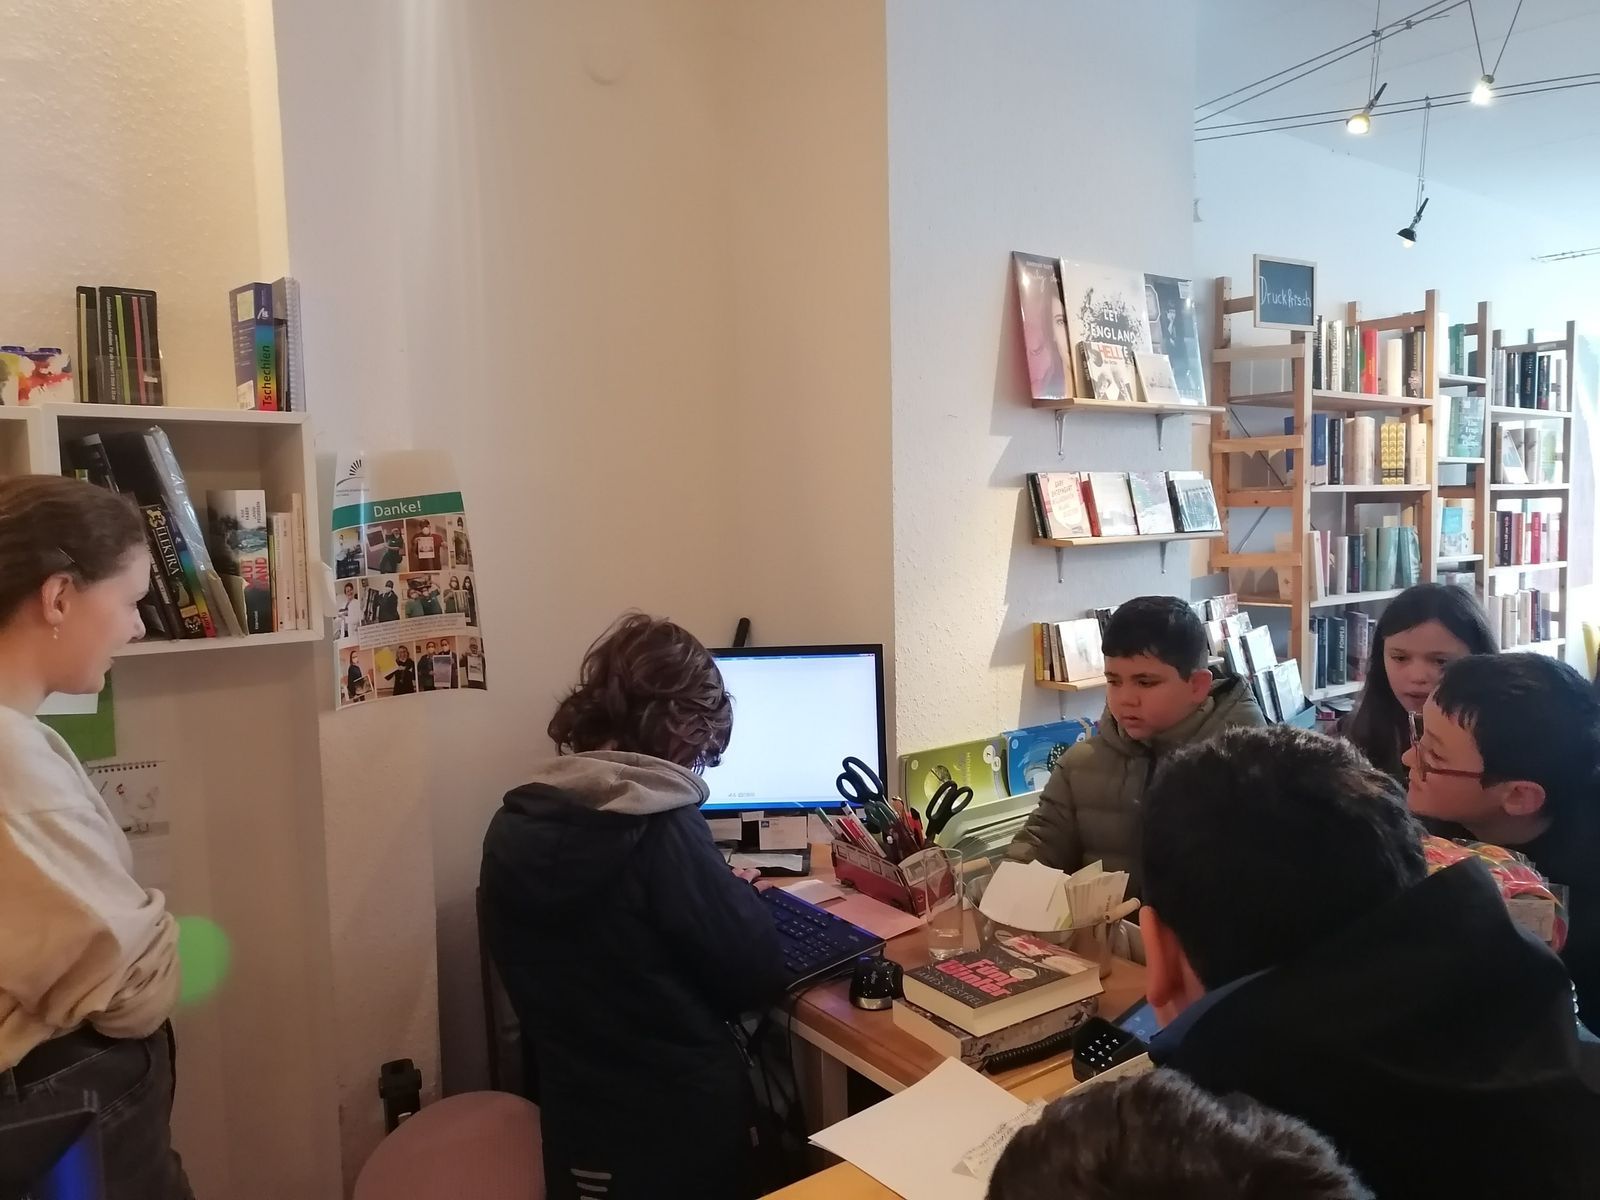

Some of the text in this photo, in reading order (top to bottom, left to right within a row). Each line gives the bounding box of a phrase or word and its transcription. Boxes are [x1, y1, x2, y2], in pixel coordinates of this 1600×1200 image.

[1259, 275, 1312, 308] Druckfrisch
[1103, 310, 1119, 322] LET
[1090, 323, 1137, 343] ENGLAND
[260, 345, 272, 406] Tschechien
[373, 500, 422, 517] Danke!
[156, 526, 180, 576] ELEKTRA
[935, 959, 1012, 997] Winter
